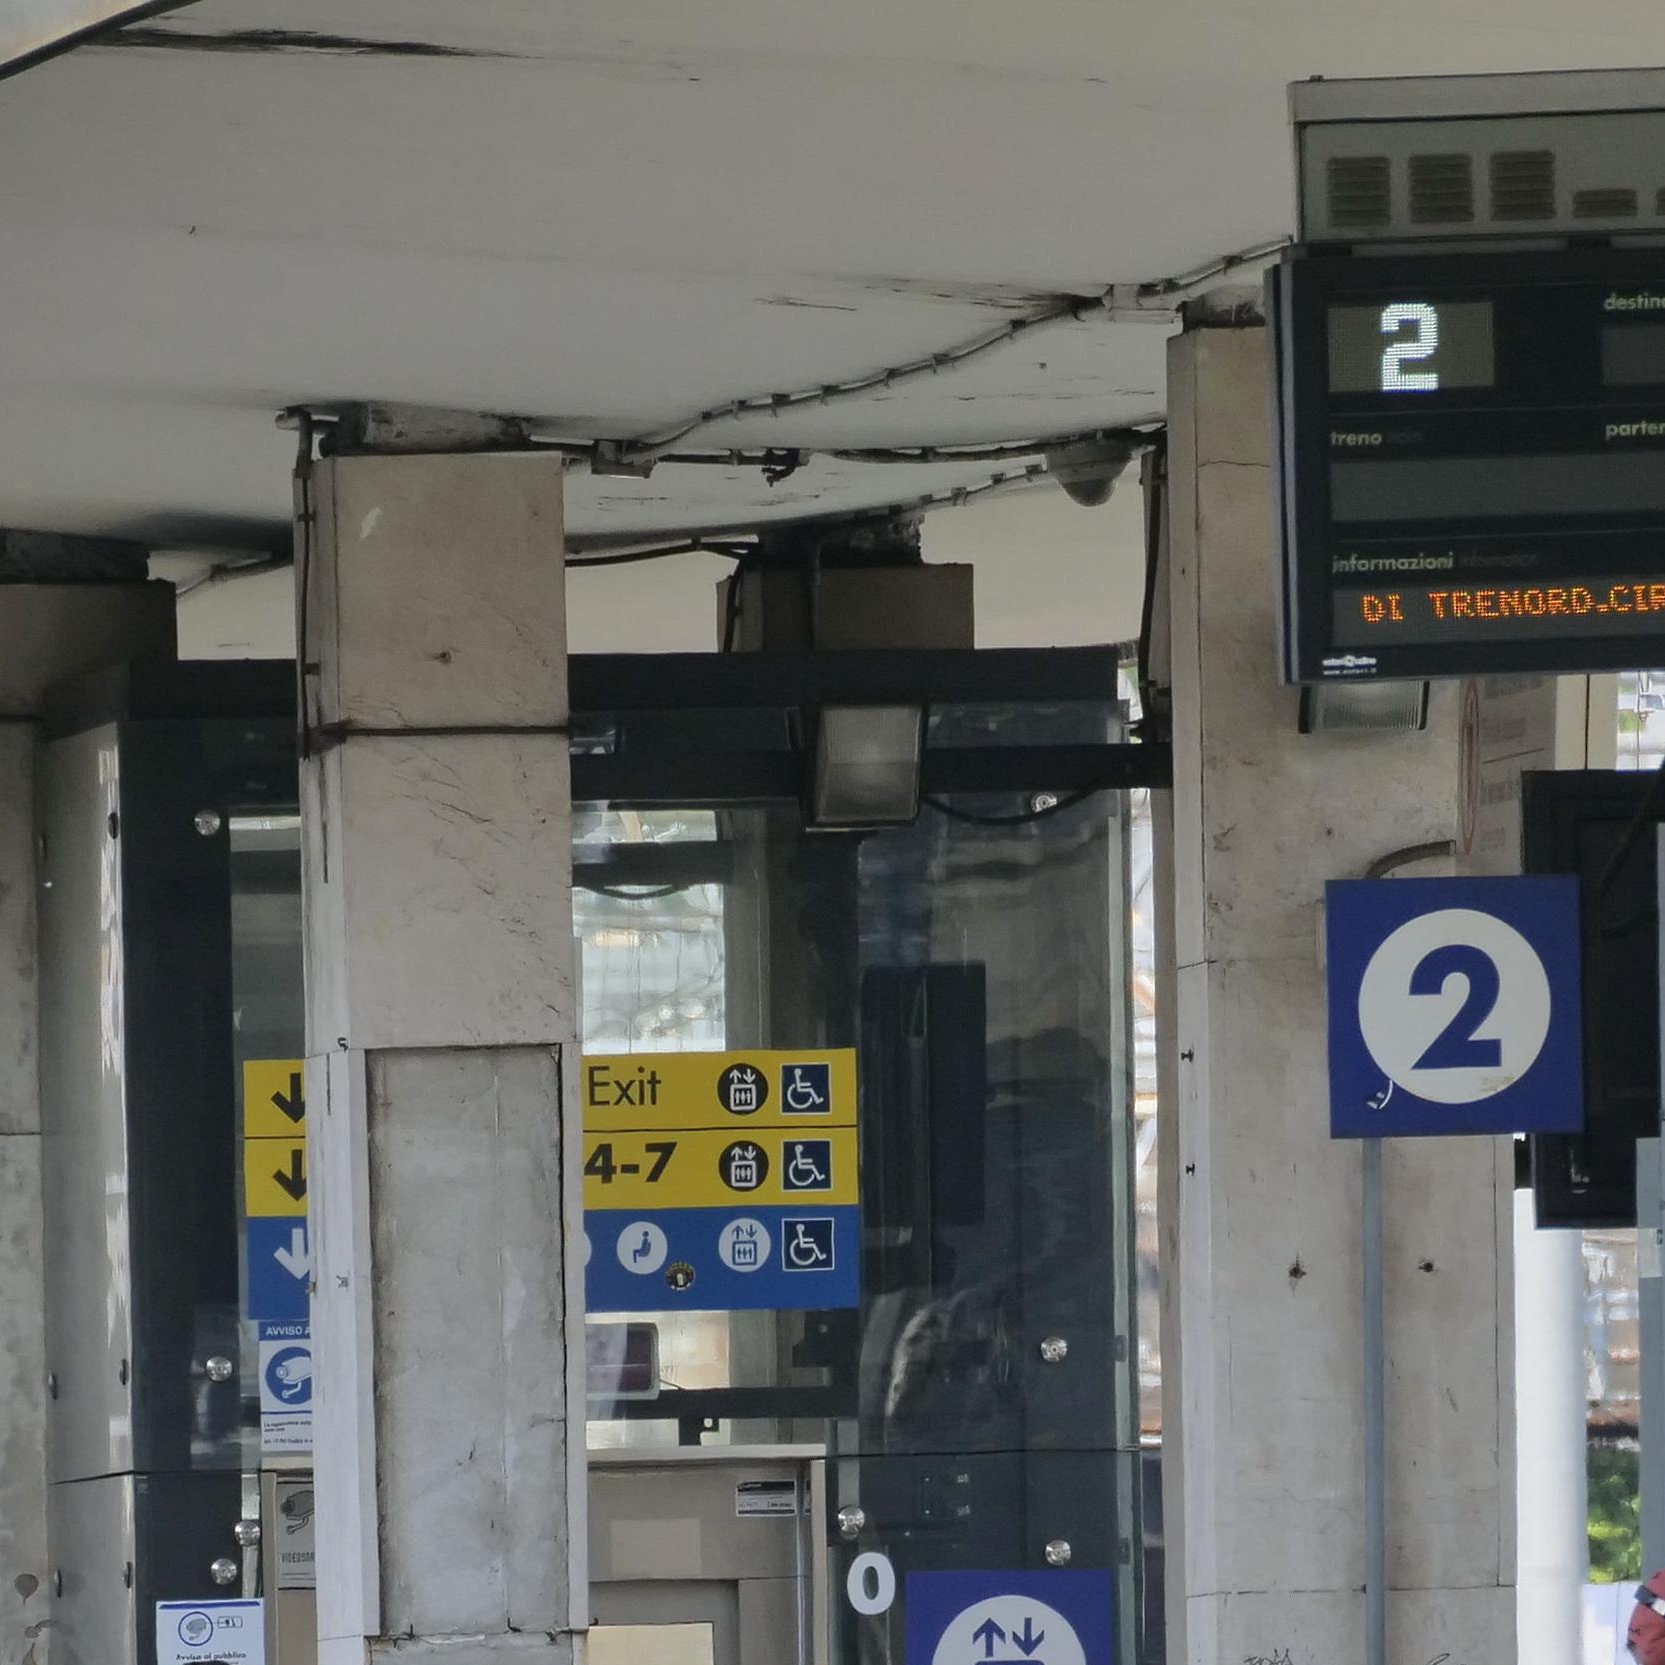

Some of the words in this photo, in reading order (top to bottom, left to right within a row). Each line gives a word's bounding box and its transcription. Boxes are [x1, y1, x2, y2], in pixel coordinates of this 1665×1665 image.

[1381, 303, 1438, 392] 2
[1330, 430, 1382, 447] treno
[1332, 551, 1454, 573] informazioni
[1361, 592, 1403, 623] DI
[1408, 944, 1502, 1070] 2
[588, 1066, 662, 1107] Exit
[583, 1142, 677, 1184] 4-7
[265, 1325, 303, 1337] AVVISO
[847, 1552, 895, 1615] 0
